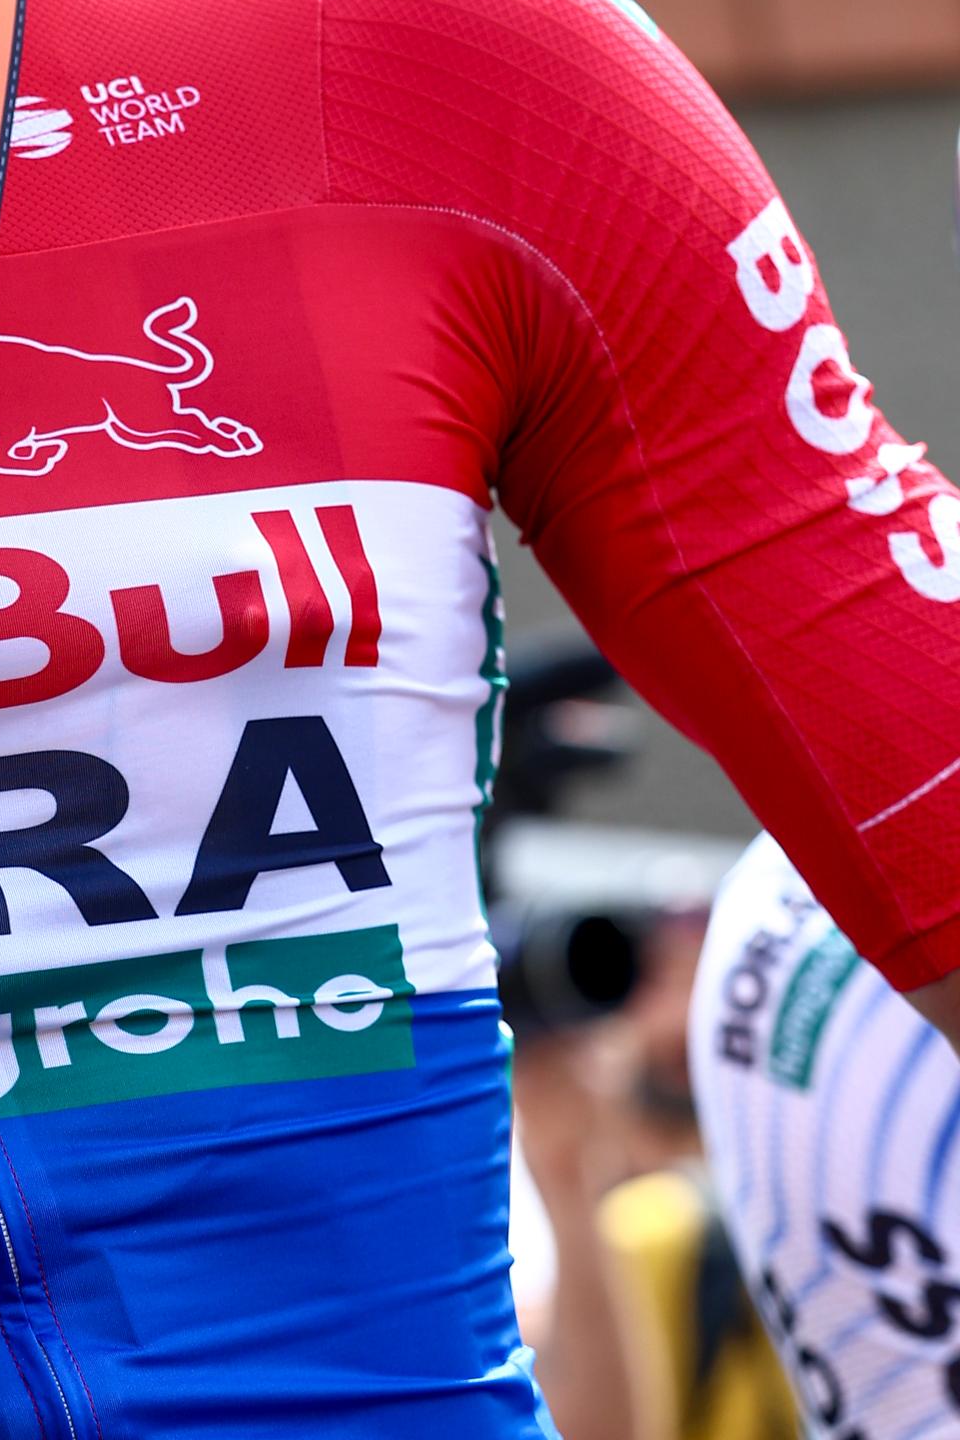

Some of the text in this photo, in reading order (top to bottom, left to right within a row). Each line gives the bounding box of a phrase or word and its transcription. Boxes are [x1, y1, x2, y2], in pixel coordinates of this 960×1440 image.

[80, 76, 145, 105] UCI
[89, 85, 201, 127] WORLD
[98, 112, 186, 148] TEAM
